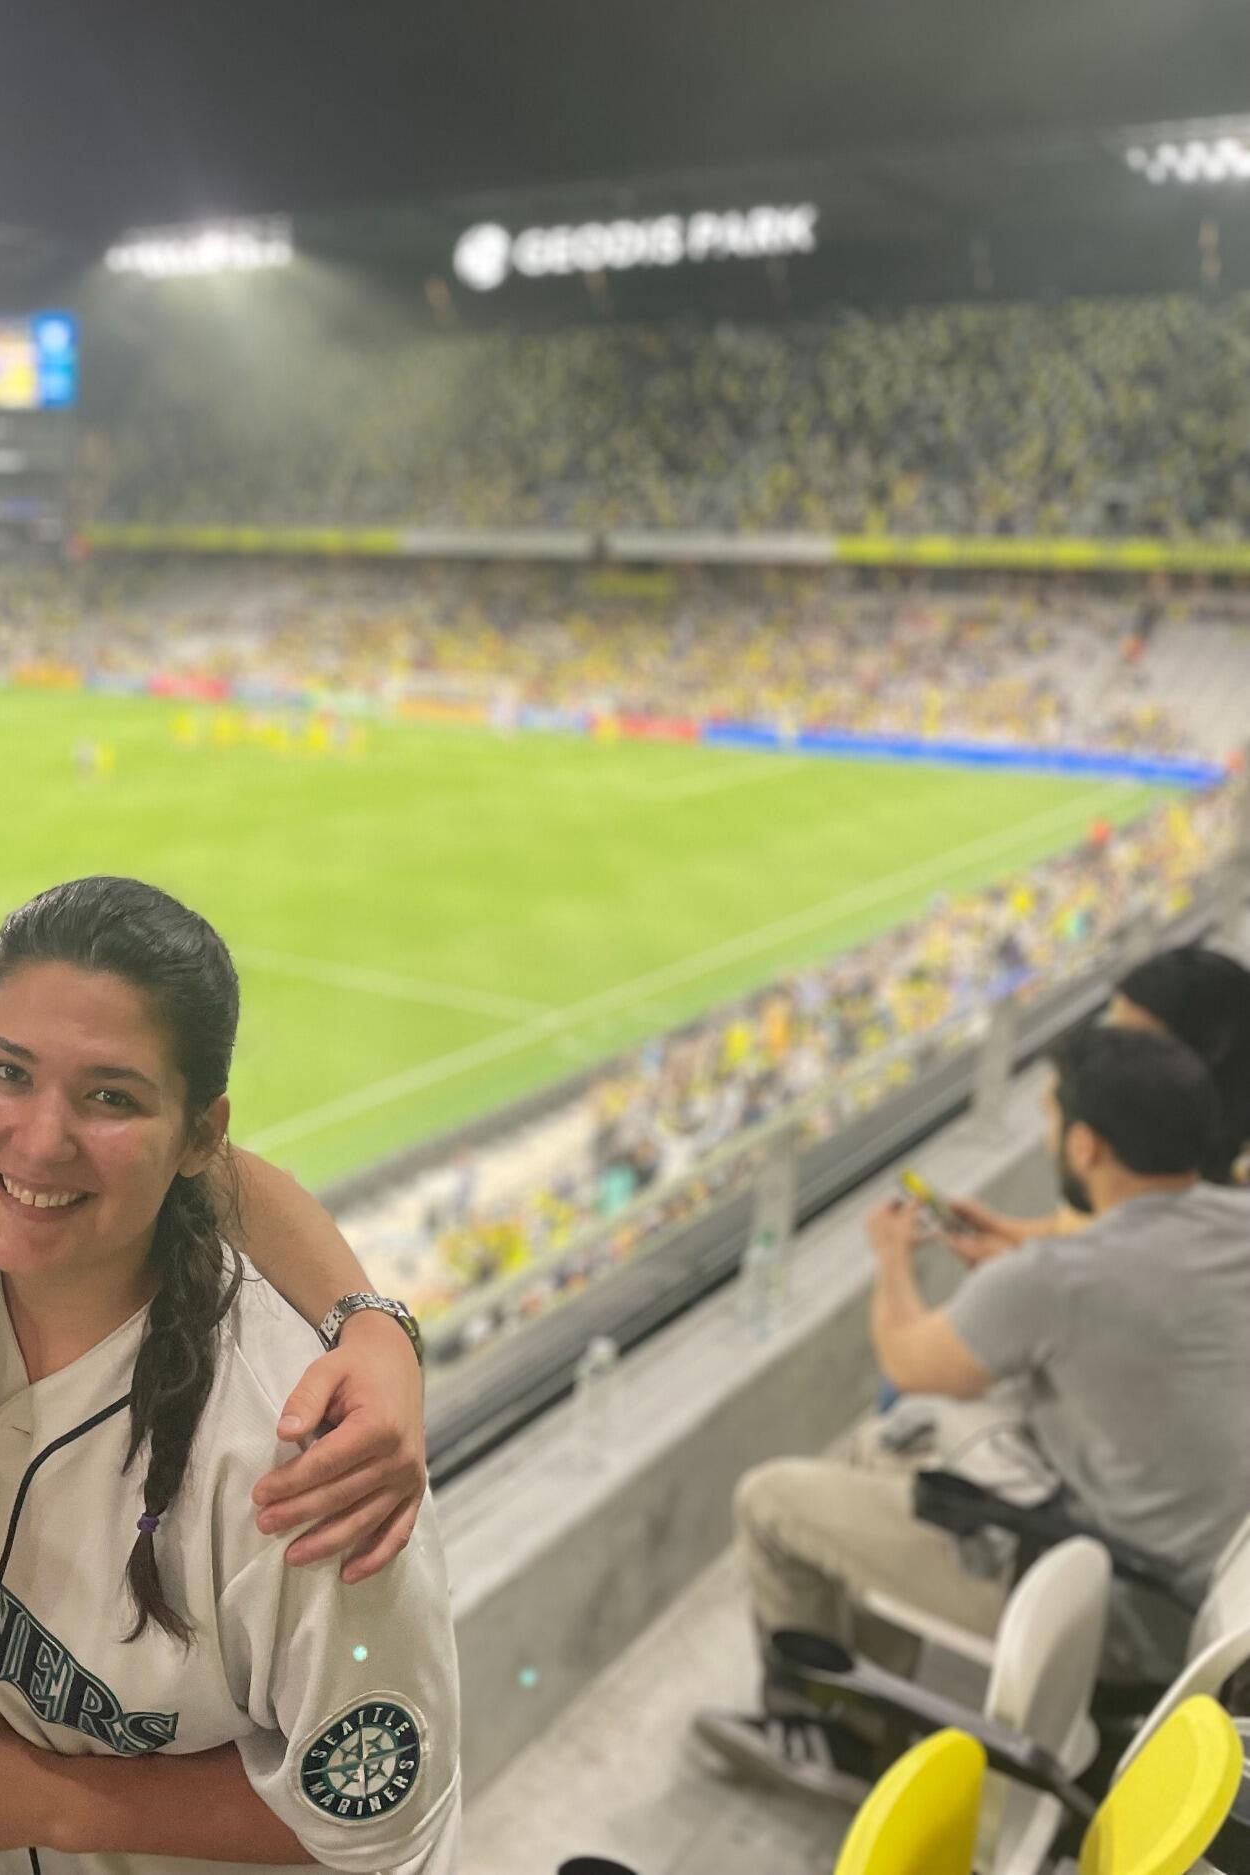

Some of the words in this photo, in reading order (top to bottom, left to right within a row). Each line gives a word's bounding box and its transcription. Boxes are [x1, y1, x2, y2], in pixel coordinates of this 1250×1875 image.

[512, 214, 684, 277] GEODIS
[686, 202, 818, 261] PARK
[310, 1706, 411, 1760] SEATTLE
[308, 1758, 416, 1816] MARINERS
